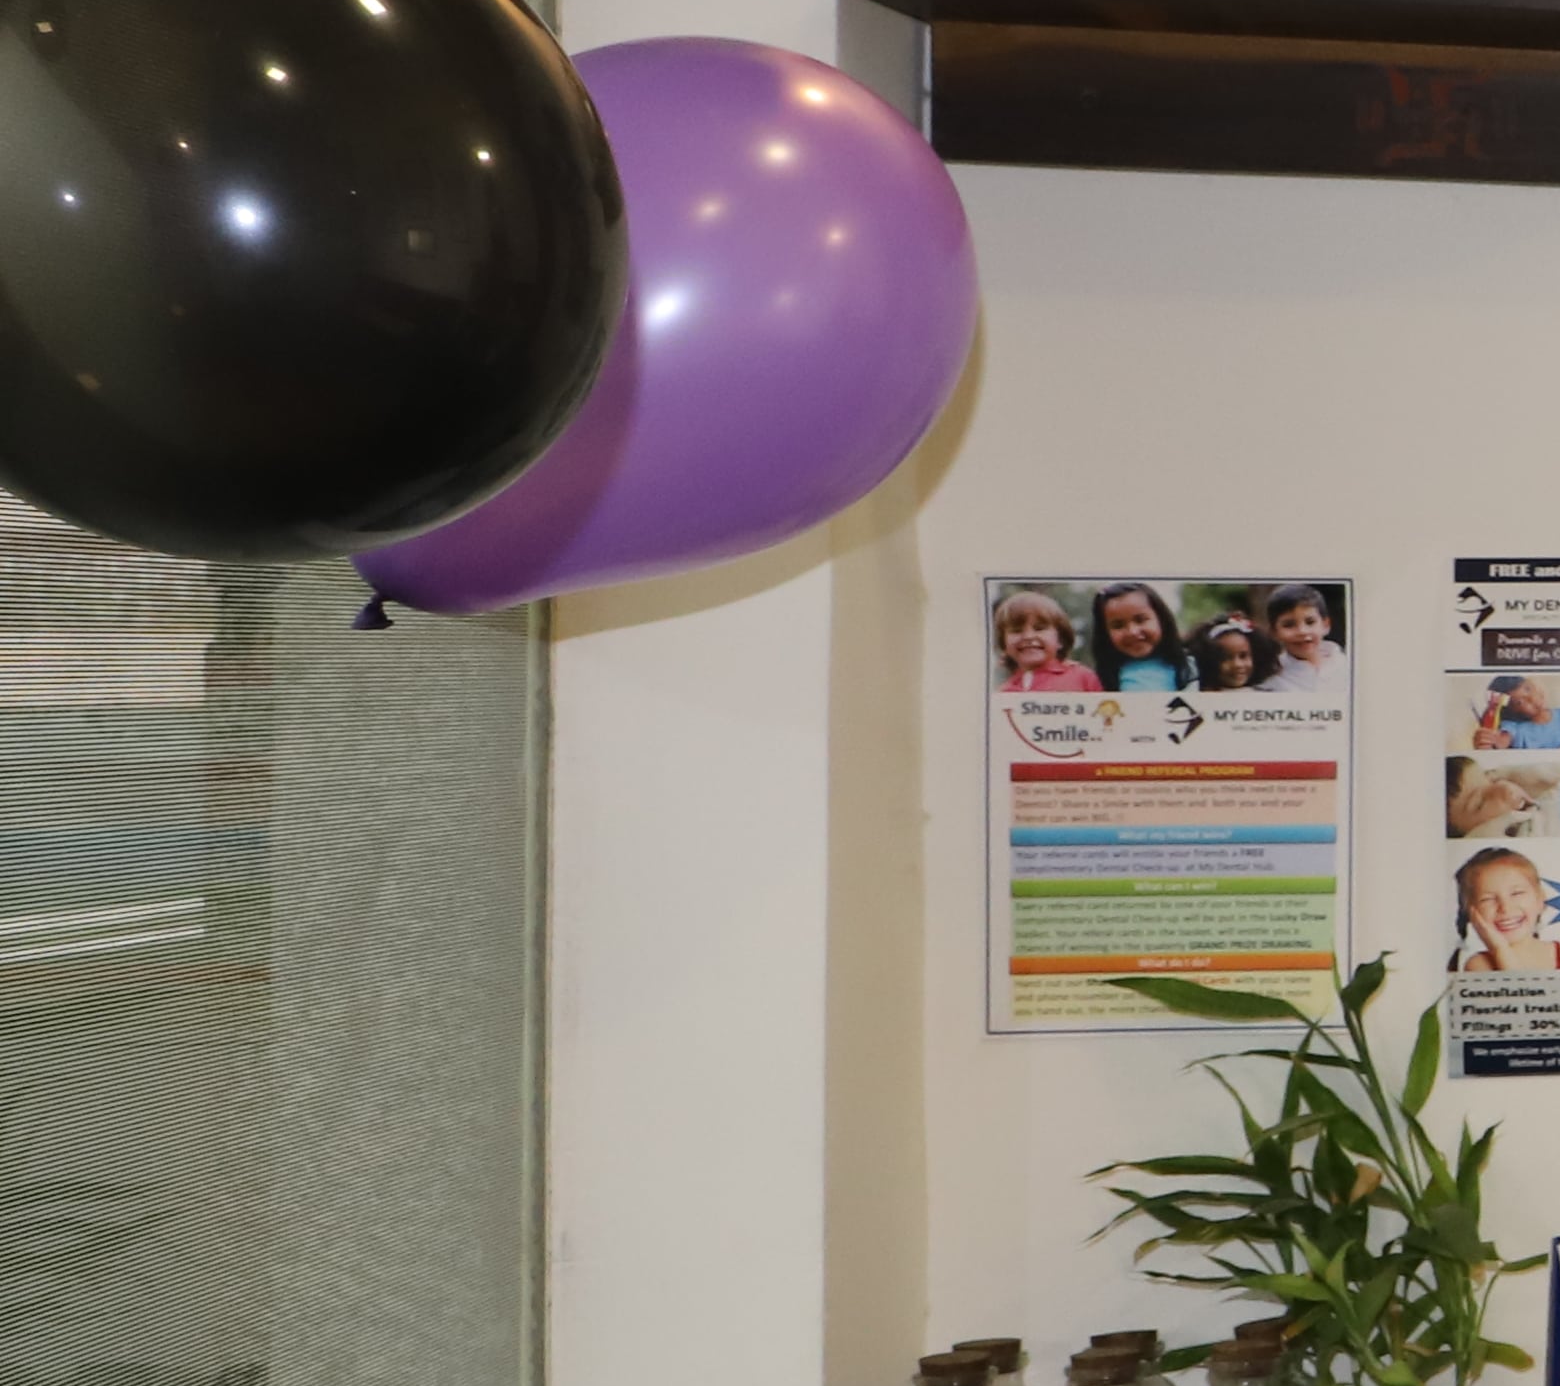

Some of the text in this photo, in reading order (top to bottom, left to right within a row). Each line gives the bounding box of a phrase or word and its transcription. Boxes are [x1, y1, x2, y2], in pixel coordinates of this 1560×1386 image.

[1489, 563, 1531, 578] FREE
[1505, 600, 1529, 611] MY
[1021, 702, 1085, 715] Share a
[1214, 710, 1342, 722] MY DENTAL HUB
[1461, 1021, 1512, 1033] Fillings
